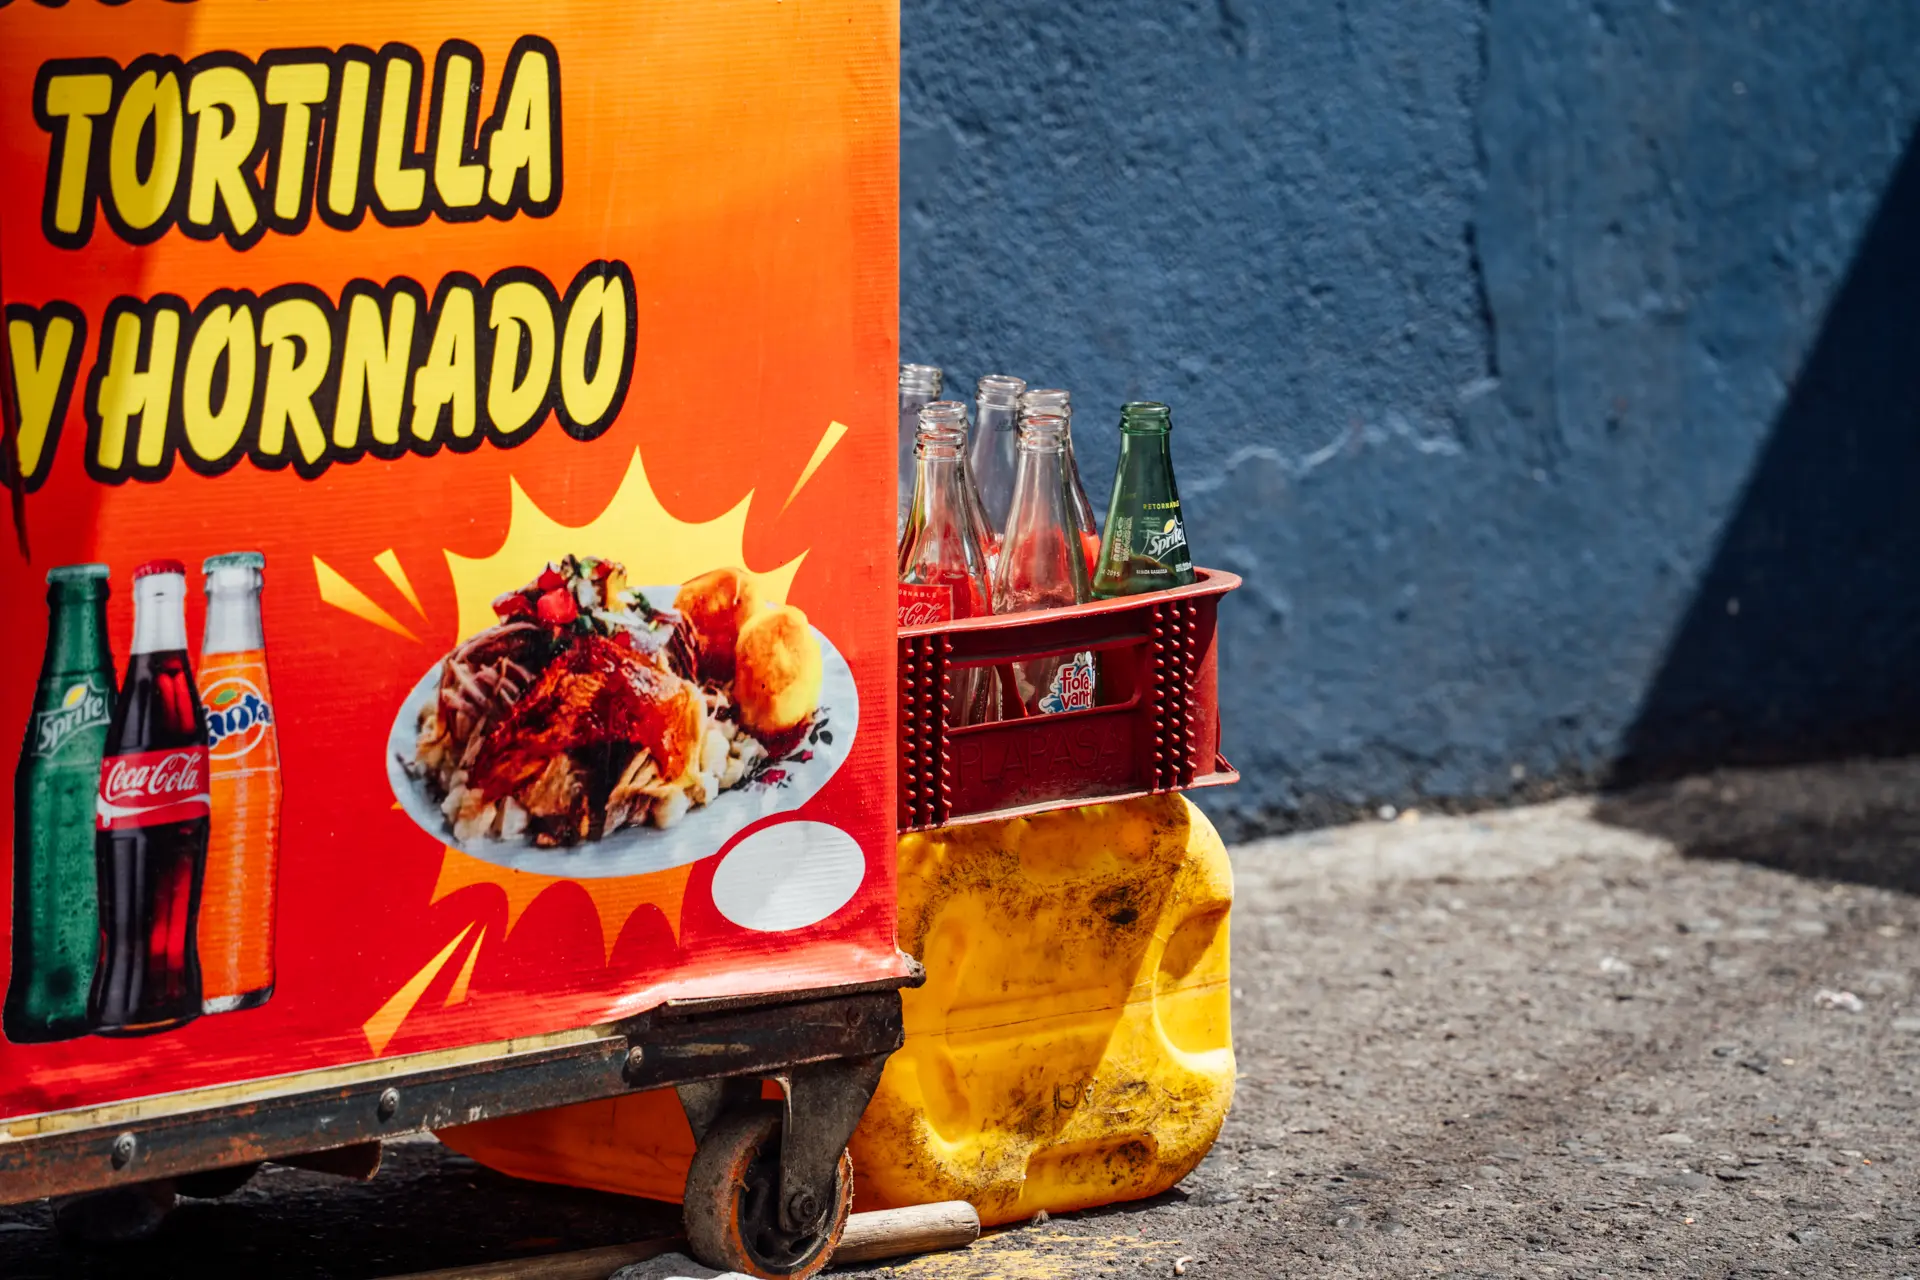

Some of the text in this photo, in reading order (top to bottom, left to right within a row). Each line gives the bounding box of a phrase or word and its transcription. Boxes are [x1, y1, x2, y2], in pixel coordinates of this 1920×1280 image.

[38, 40, 558, 246] TORTILLA
[5, 265, 634, 488] Y HORNADO
[1148, 527, 1183, 555] Sprite
[898, 589, 938, 599] ORNABLE
[39, 690, 104, 751] Sprite
[105, 752, 202, 802] Coca-Cola
